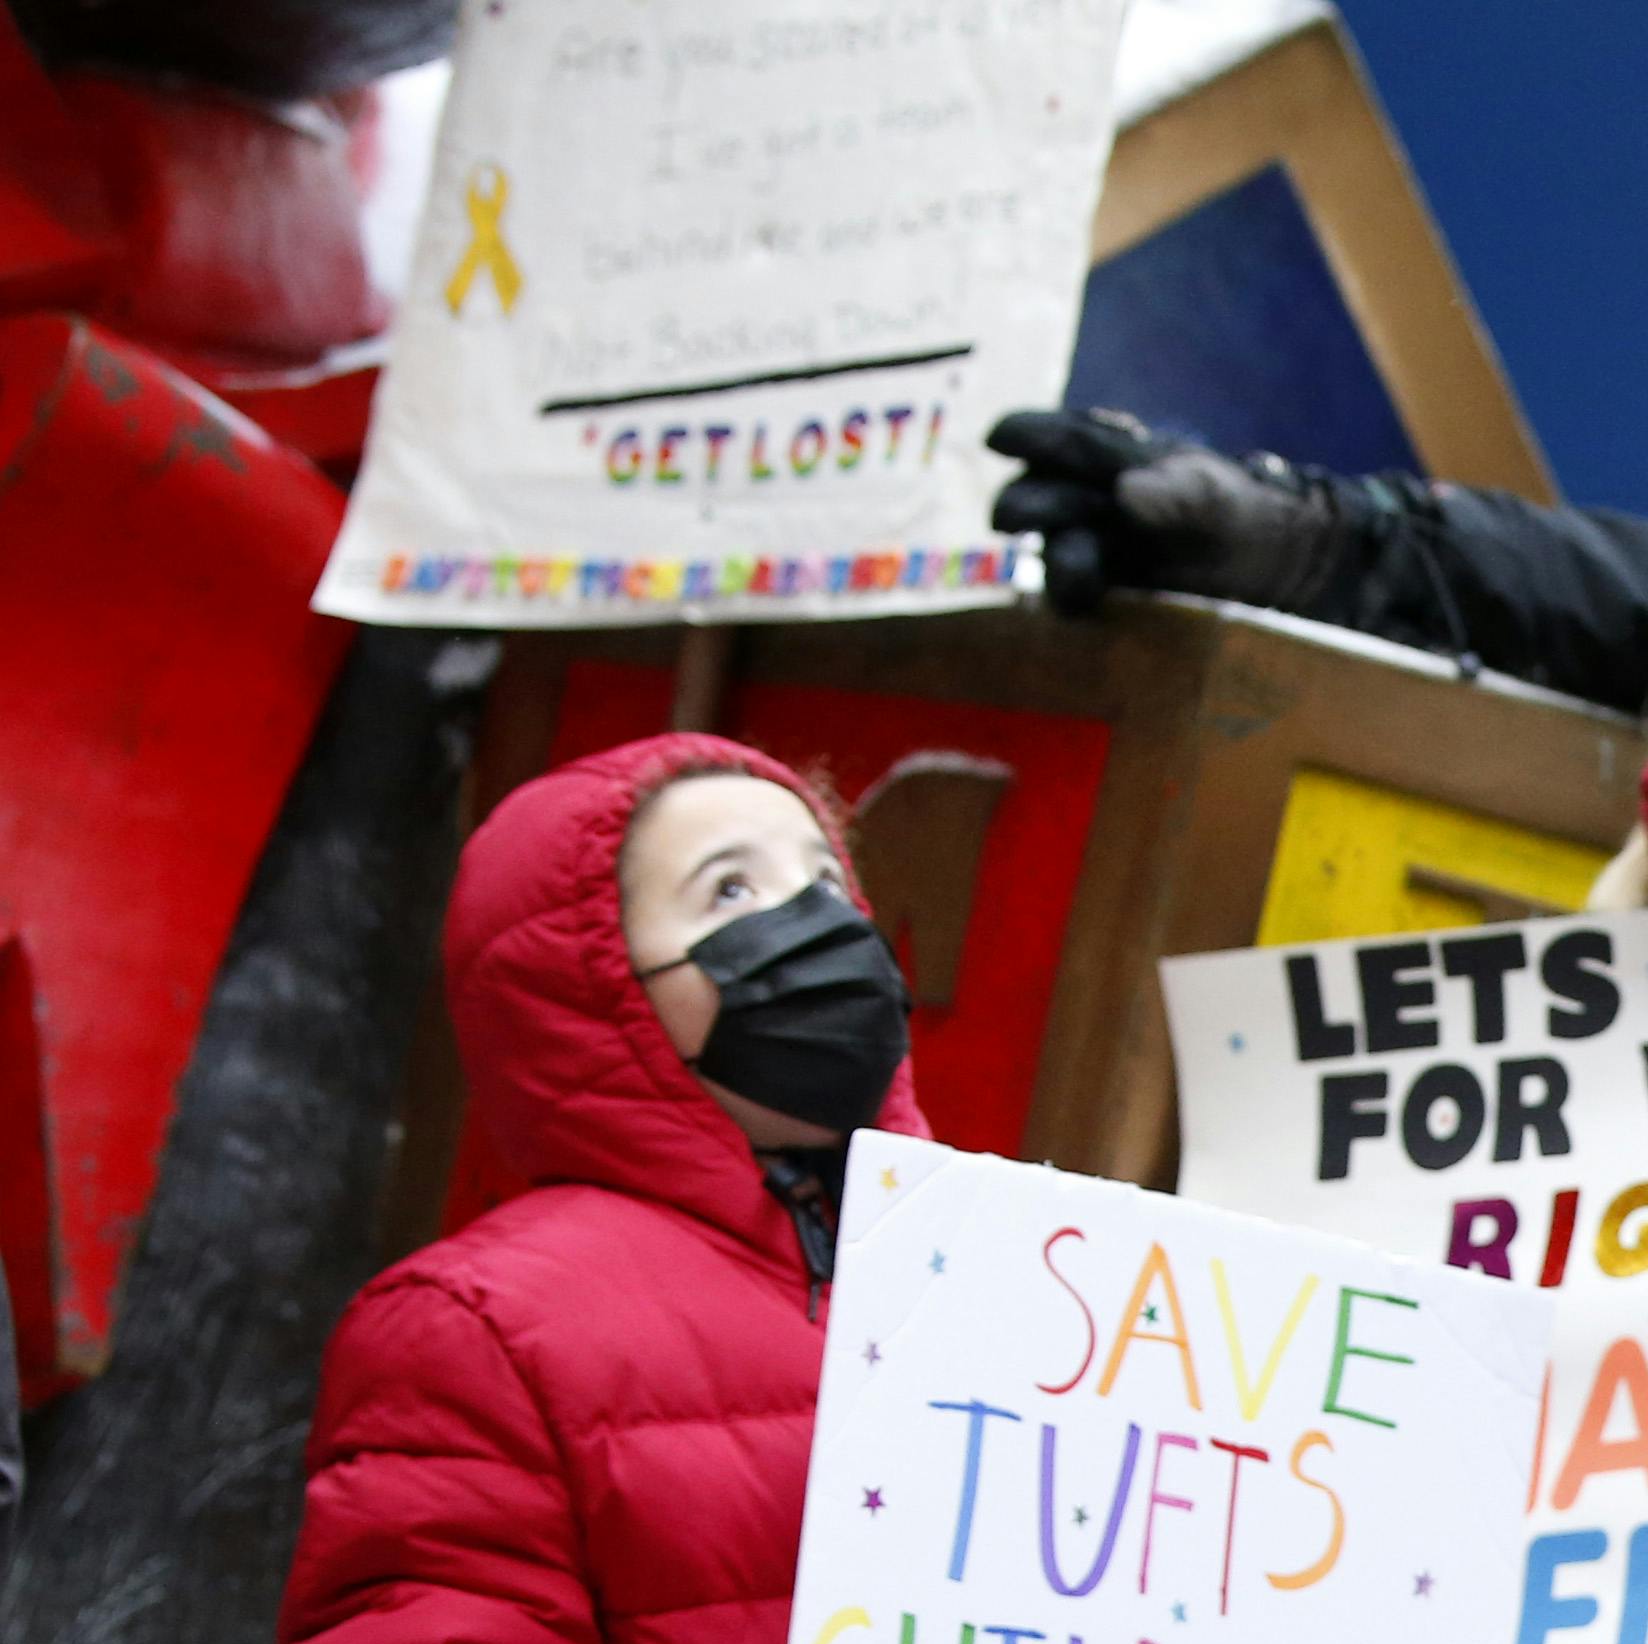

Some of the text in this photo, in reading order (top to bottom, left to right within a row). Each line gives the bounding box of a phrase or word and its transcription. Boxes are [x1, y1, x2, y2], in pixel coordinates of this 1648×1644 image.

[1284, 928, 1622, 1062] LETS
[1317, 1055, 1570, 1181] FOR
[1036, 1227, 1420, 1428] SAVE
[927, 1398, 1345, 1615] TUFTS
